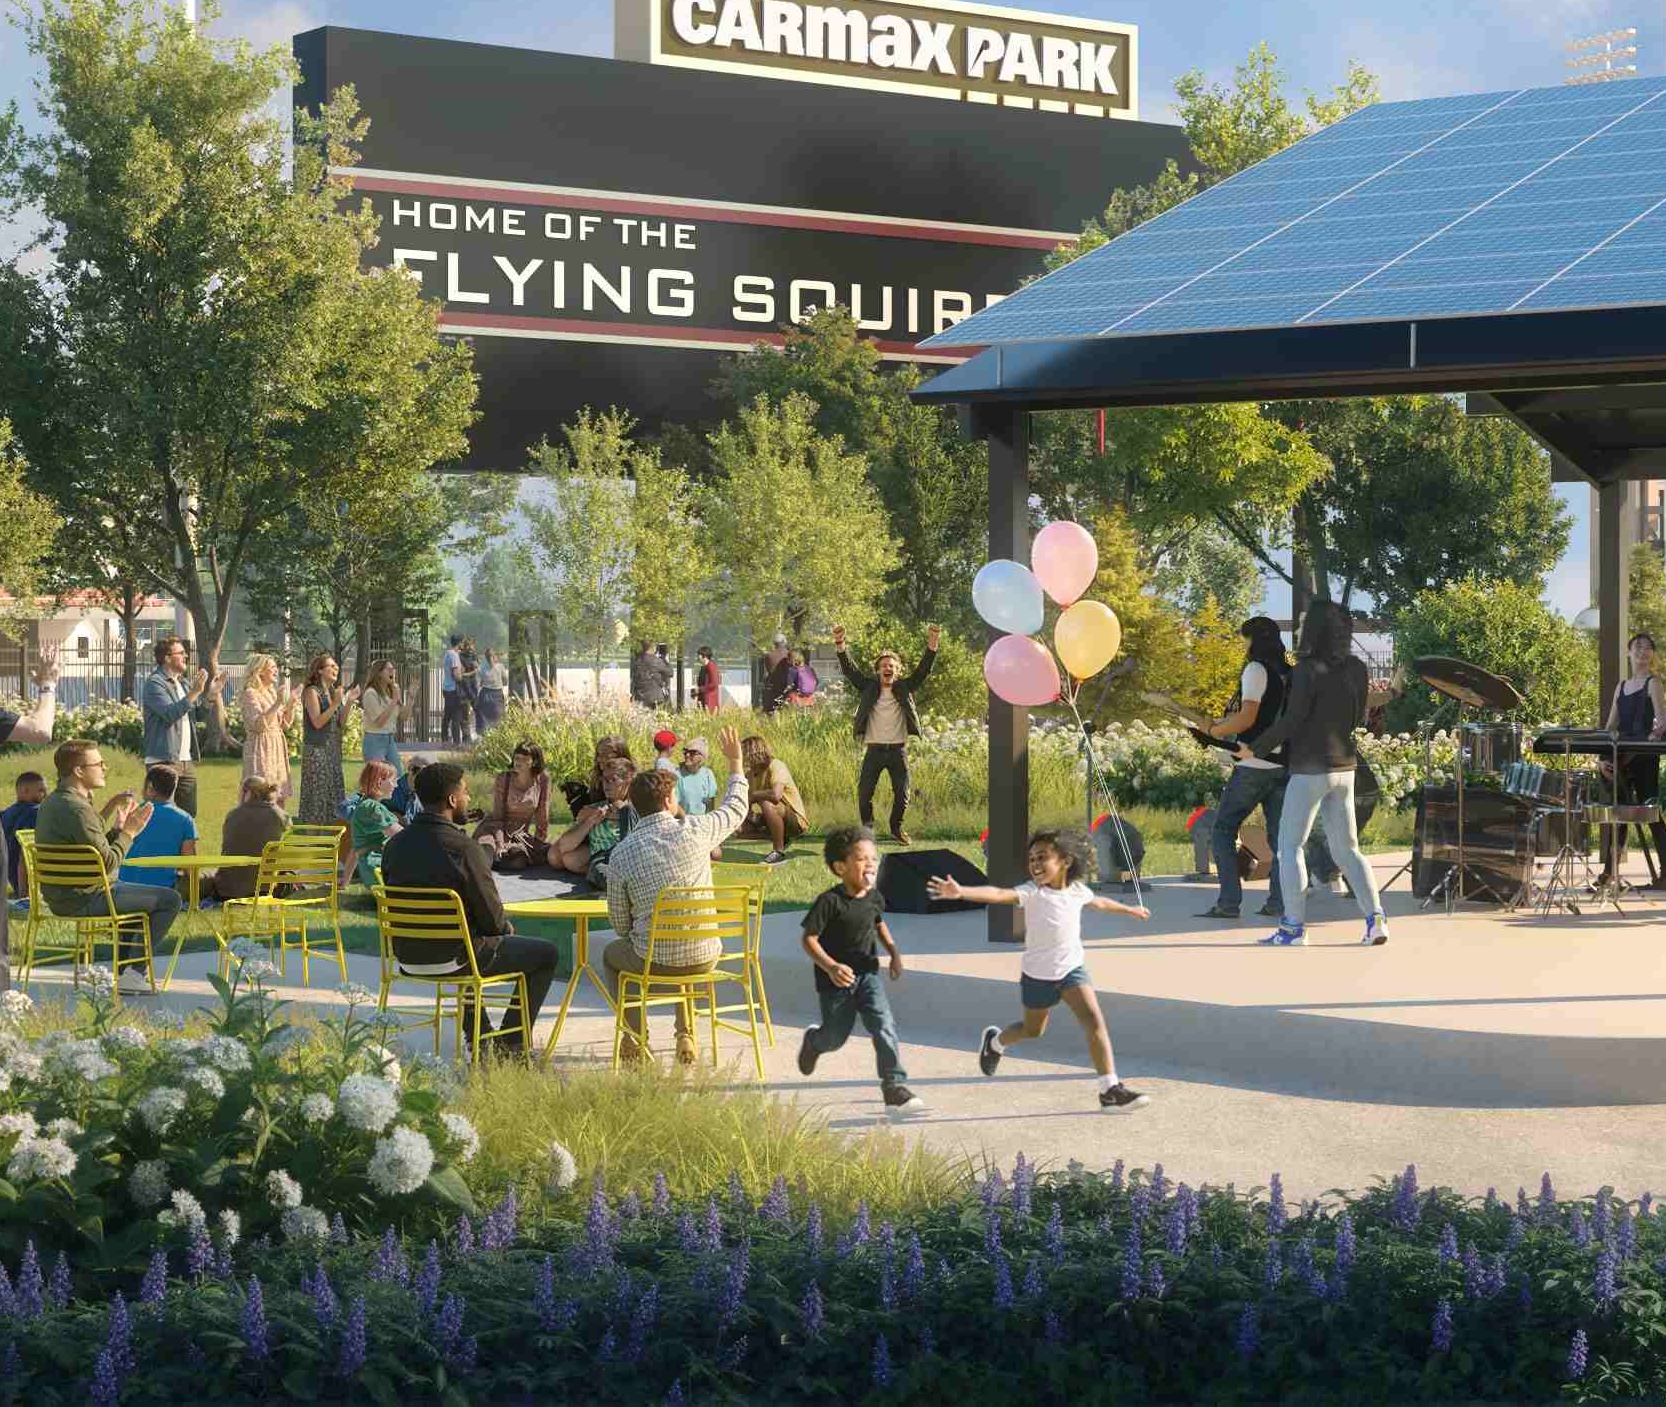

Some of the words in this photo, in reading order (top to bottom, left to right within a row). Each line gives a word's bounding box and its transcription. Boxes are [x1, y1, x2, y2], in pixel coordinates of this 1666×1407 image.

[966, 25, 1120, 95] PARK
[393, 198, 526, 236] HOME
[544, 212, 602, 242] OF
[612, 217, 697, 250] THE
[732, 274, 1009, 335] SQUIR
